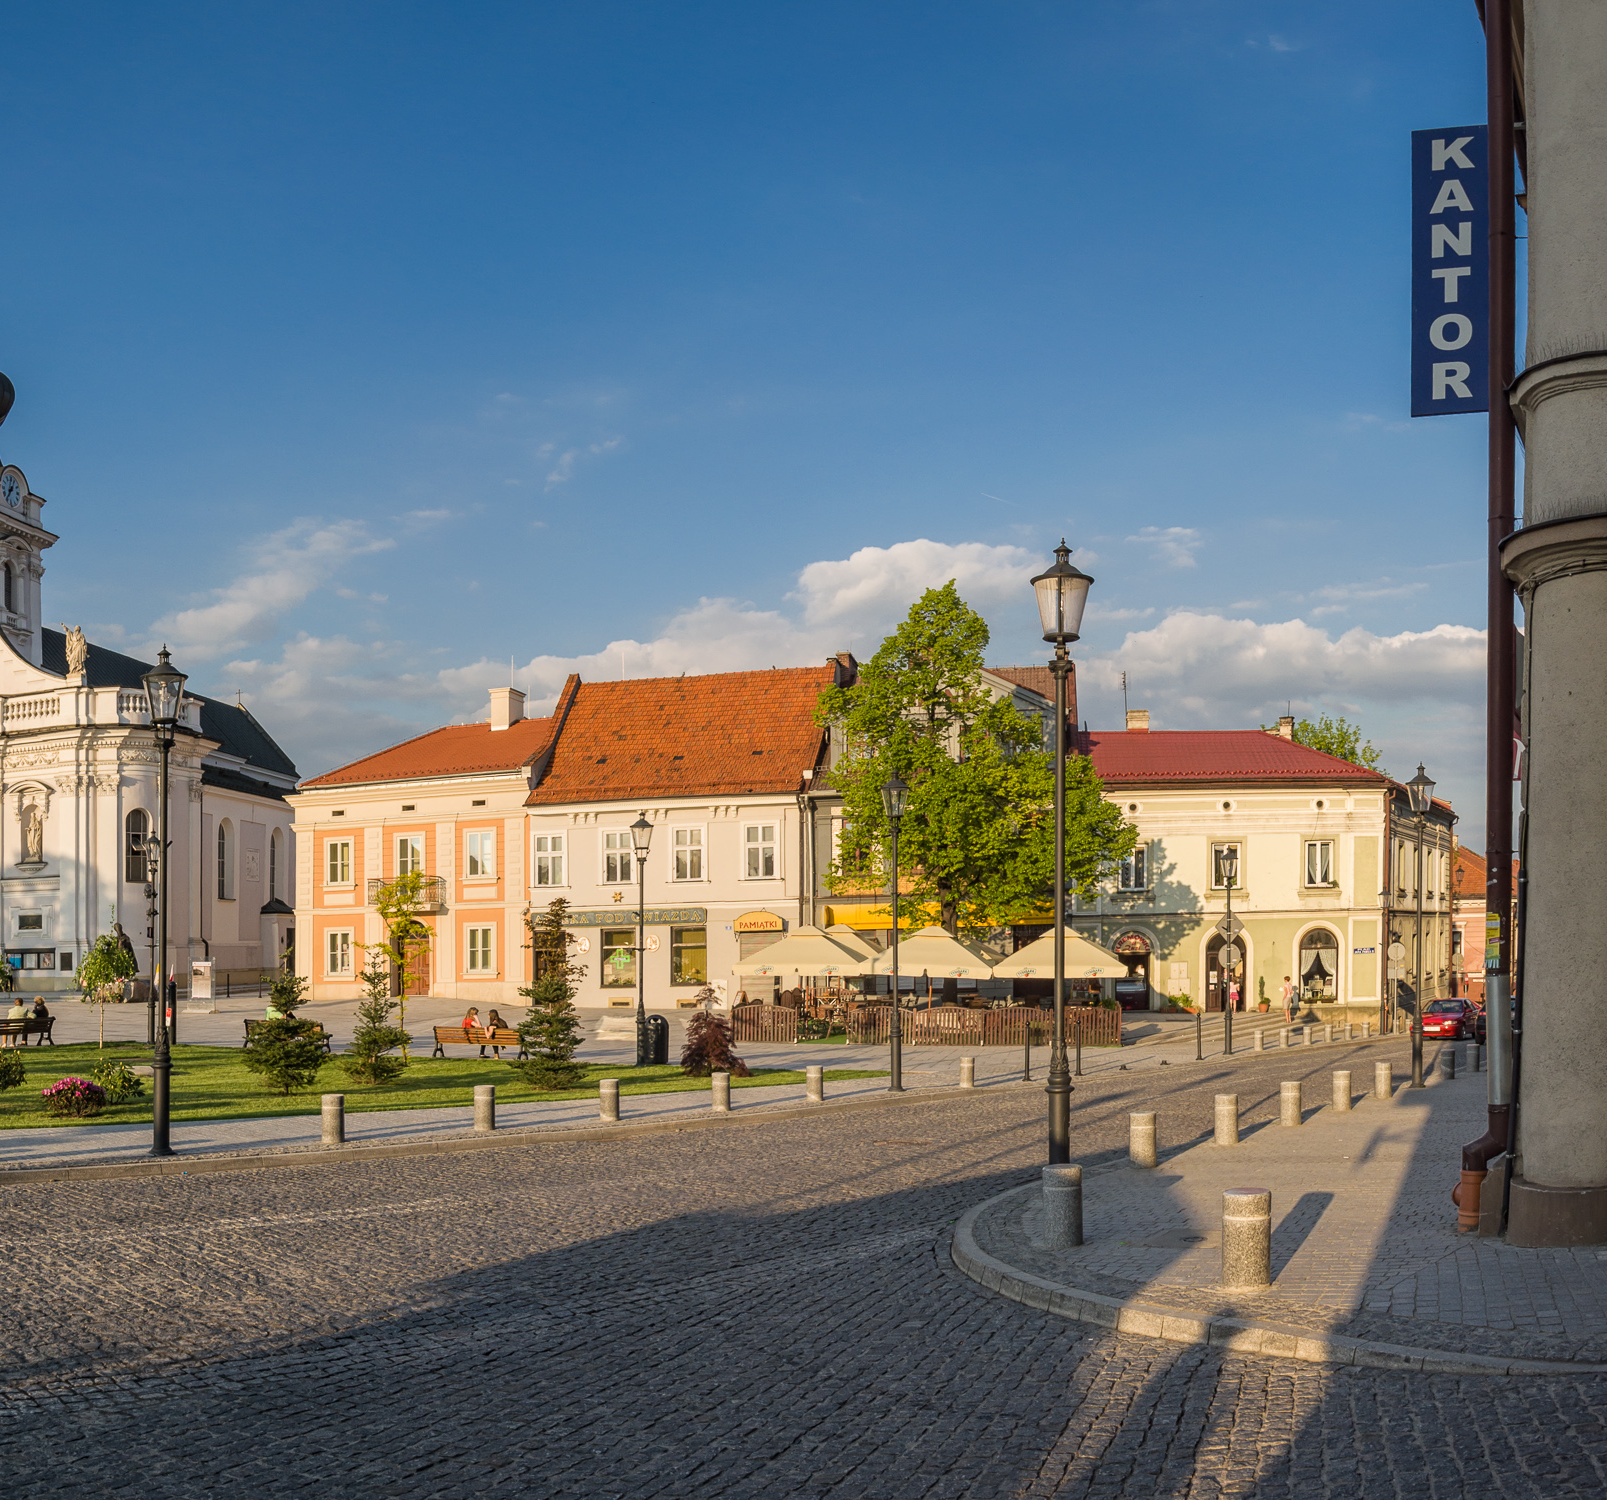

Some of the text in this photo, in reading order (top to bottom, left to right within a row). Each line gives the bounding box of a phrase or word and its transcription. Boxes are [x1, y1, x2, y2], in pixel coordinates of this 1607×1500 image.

[1428, 135, 1476, 401] KANTOR
[595, 913, 625, 924] POD
[739, 920, 778, 930] PAMIĄTKI
